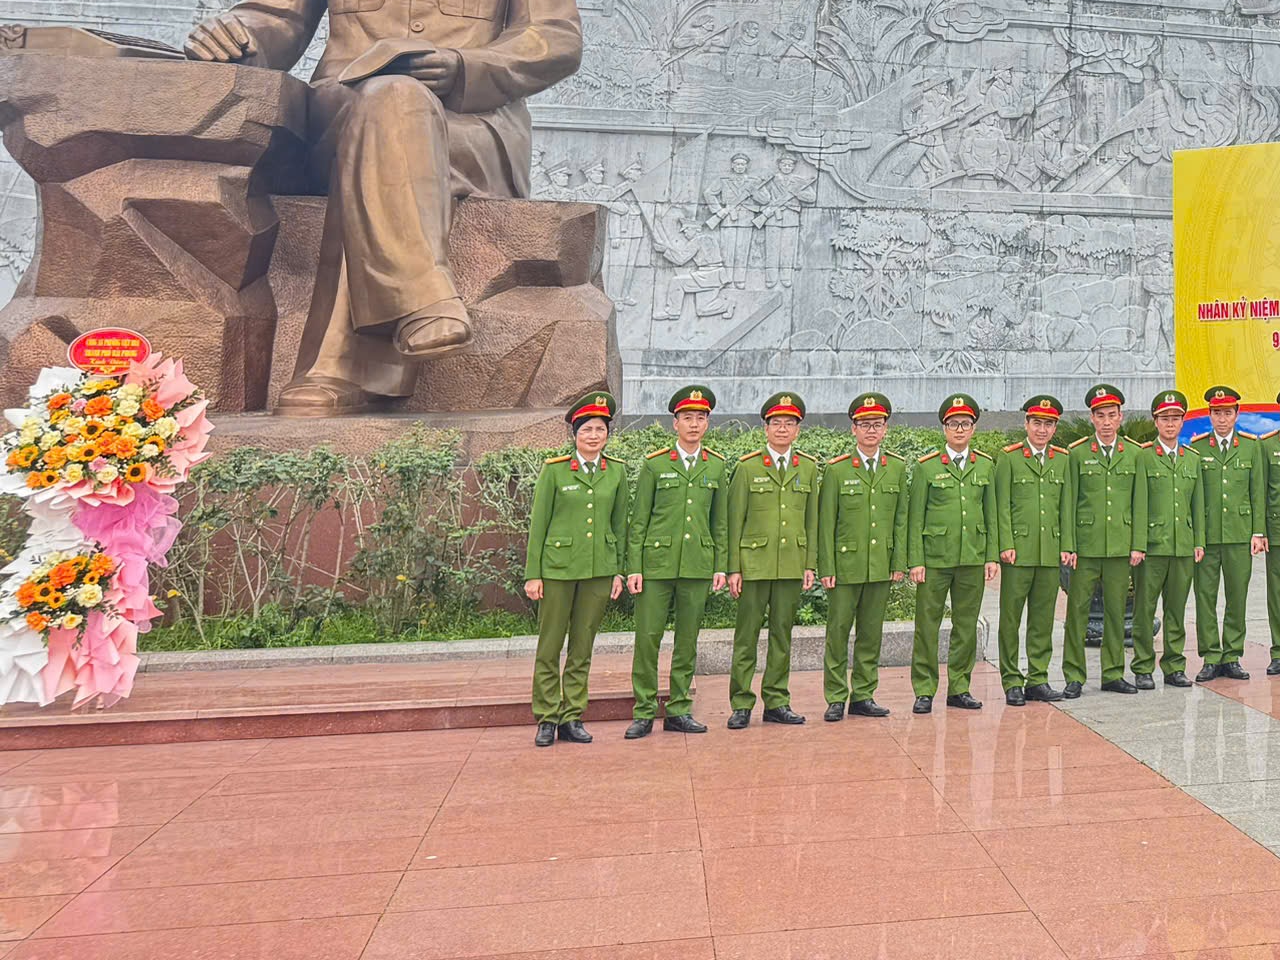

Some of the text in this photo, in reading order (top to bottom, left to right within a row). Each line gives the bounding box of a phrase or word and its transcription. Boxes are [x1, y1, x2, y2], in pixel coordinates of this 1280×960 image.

[1198, 299, 1229, 320] NHÂN
[1232, 296, 1247, 318] KỶ
[1250, 297, 1279, 321] NIỆM
